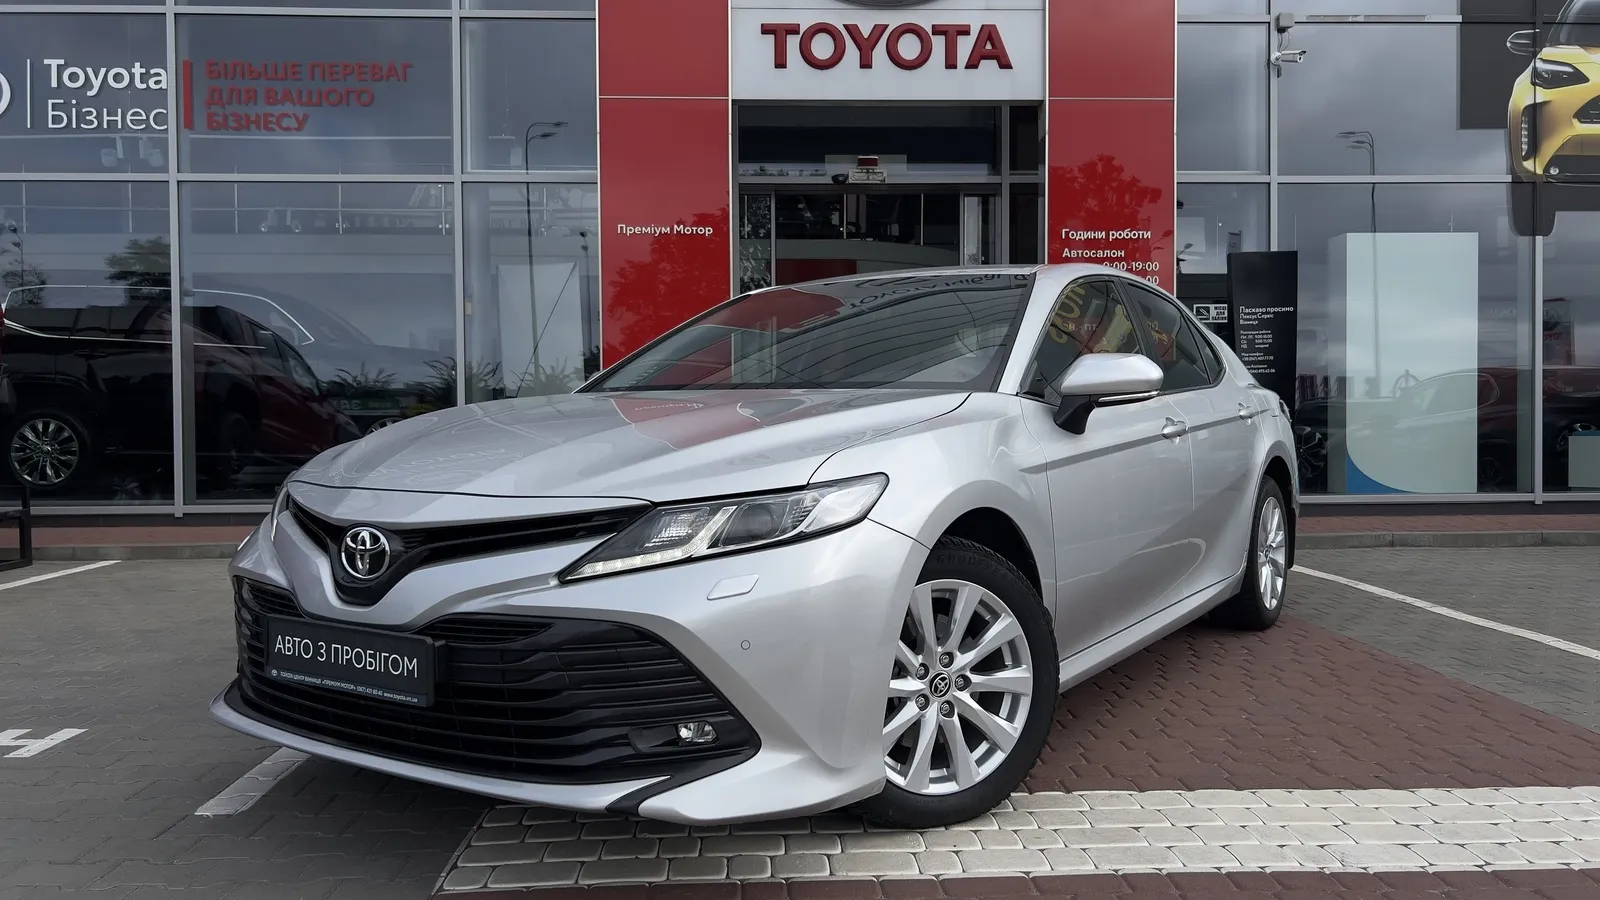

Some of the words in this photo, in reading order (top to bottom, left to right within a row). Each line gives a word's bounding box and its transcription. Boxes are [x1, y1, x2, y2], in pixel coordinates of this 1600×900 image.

[760, 22, 1014, 71] TOYOTA
[43, 58, 168, 97] Toyota
[205, 61, 302, 81] БІЛЬШЕ
[308, 62, 414, 82] ПЕРЕВАГ
[205, 86, 257, 108] ДЛЯ
[264, 87, 375, 107] ВАШОГО
[47, 99, 168, 130] Бізнес
[206, 112, 310, 132] БІЗНЕСУ
[617, 223, 671, 237] Преміум
[673, 224, 713, 237] Мотор
[1061, 228, 1106, 241] Години
[1109, 228, 1151, 241] роботи
[1062, 247, 1125, 258] Автосалон
[274, 634, 313, 659] АВТО
[331, 644, 418, 678] ПРОБІГОМ
